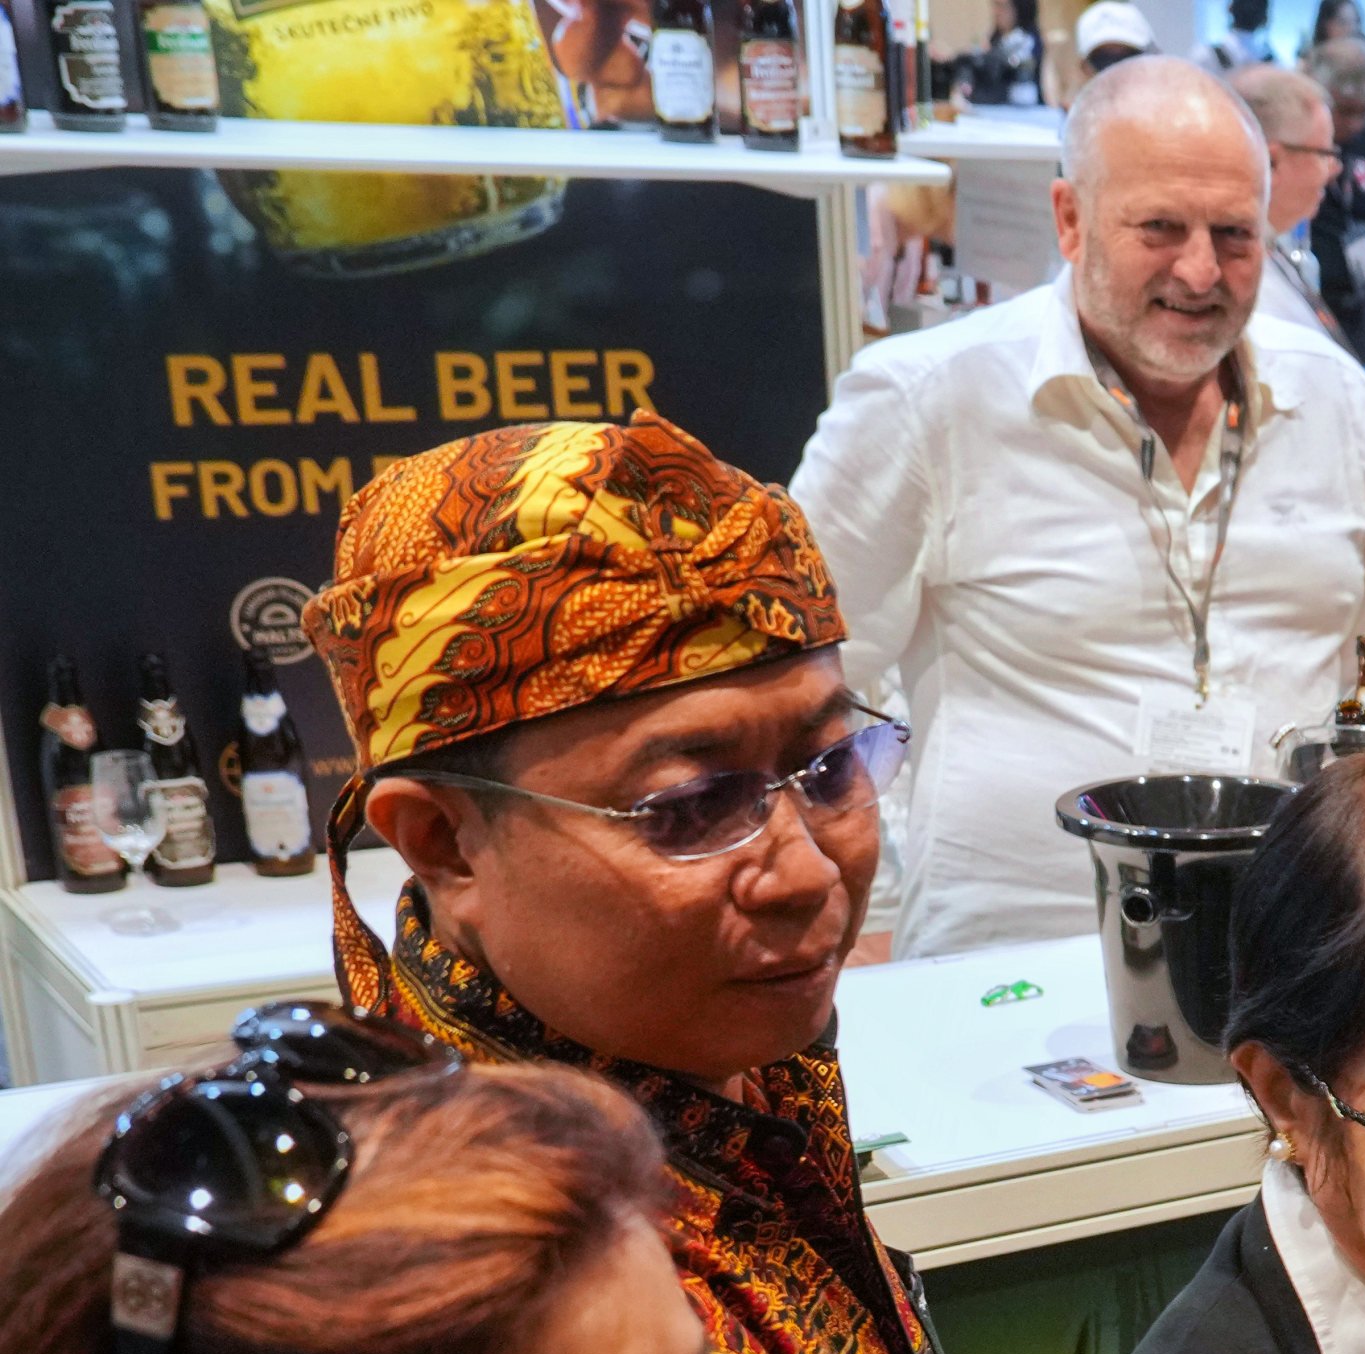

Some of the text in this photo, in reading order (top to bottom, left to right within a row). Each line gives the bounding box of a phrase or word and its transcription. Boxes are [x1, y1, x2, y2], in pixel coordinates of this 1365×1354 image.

[165, 349, 656, 427] REAL BEER
[149, 456, 353, 521] FROM
